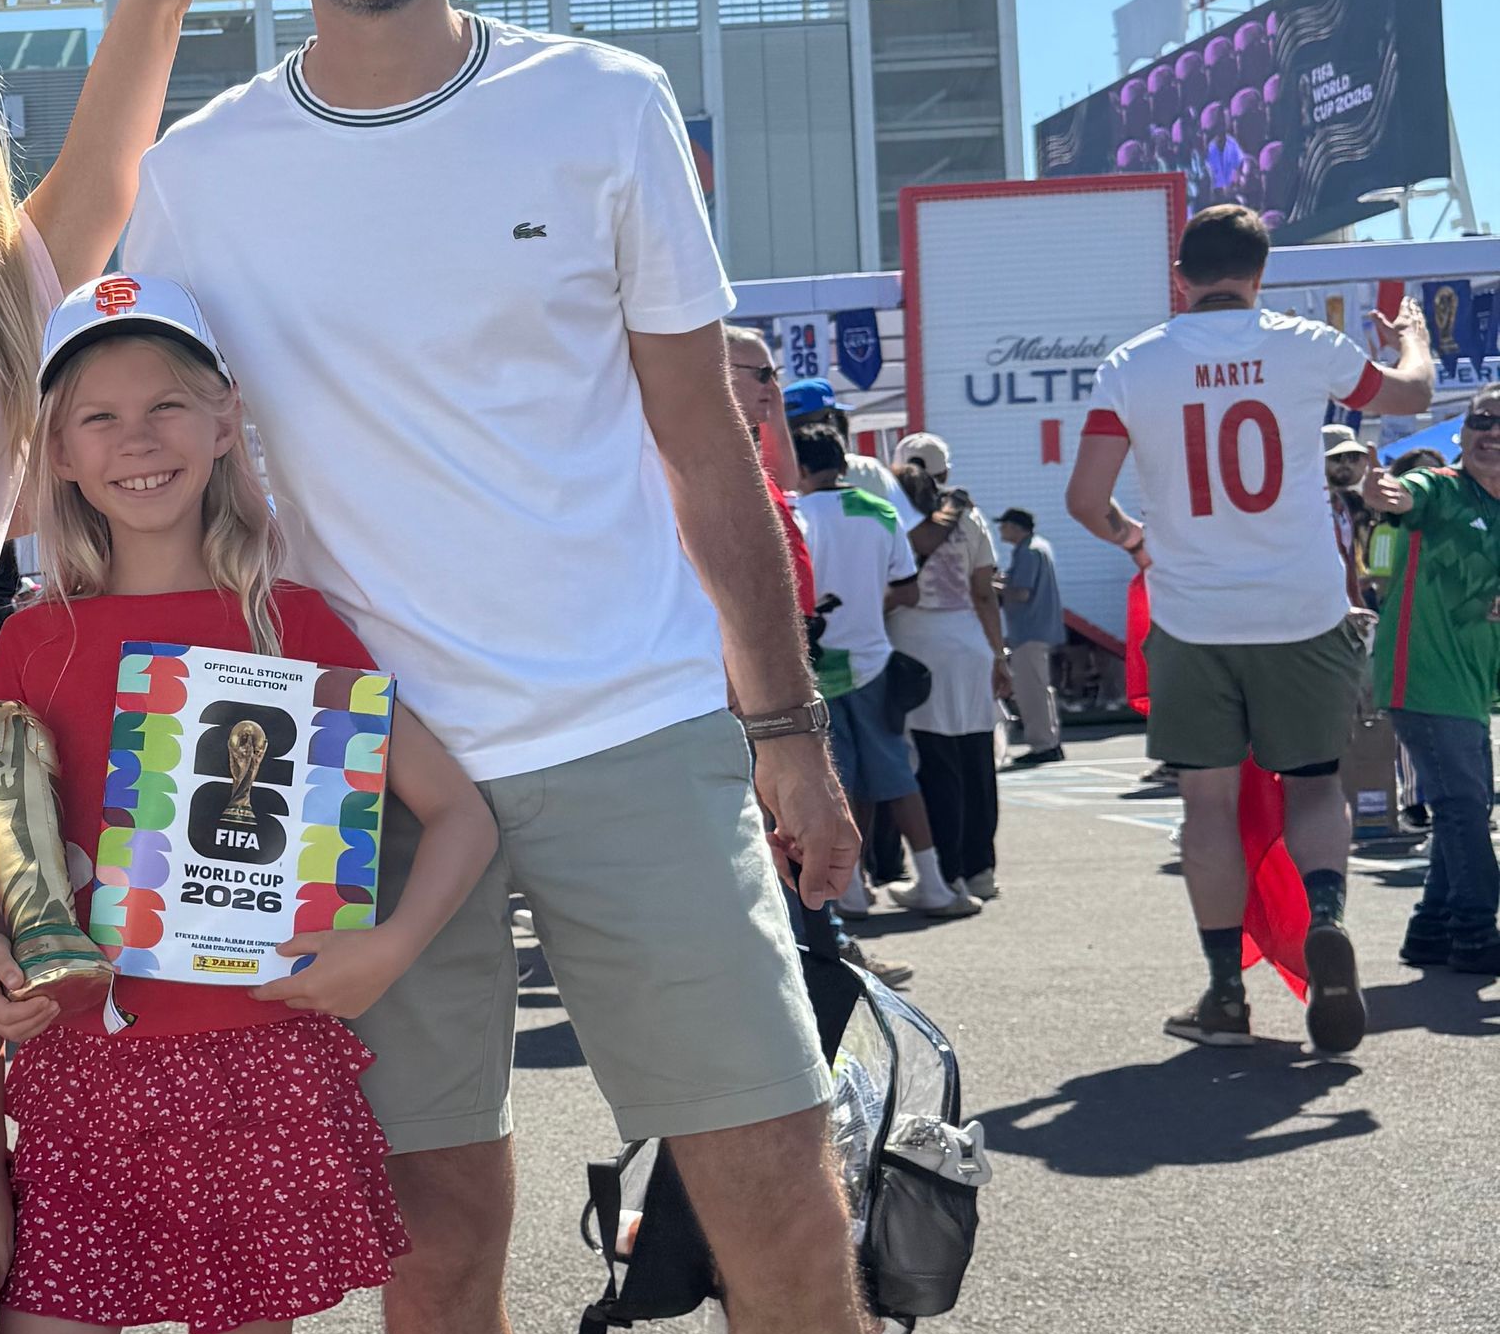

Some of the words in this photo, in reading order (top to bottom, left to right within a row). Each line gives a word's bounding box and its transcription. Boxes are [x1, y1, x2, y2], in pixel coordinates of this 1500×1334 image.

[1311, 61, 1334, 85] FIFA
[1312, 74, 1350, 104] WORLD
[1313, 99, 1334, 123] CUP
[1334, 83, 1373, 114] 2026
[986, 334, 1107, 366] Michelob
[791, 352, 818, 378] 26
[1195, 359, 1265, 388] MARTZ
[965, 368, 1098, 407] ULTR
[1183, 400, 1283, 517] 10
[204, 661, 255, 676] OFFICIAL
[257, 668, 303, 682] STICKER
[218, 675, 288, 691] COLLECTION
[215, 828, 260, 851] FIFA
[184, 863, 246, 883] WORLD
[249, 872, 284, 888] CUP
[180, 881, 282, 914] 2026
[211, 958, 256, 968] PANINI
